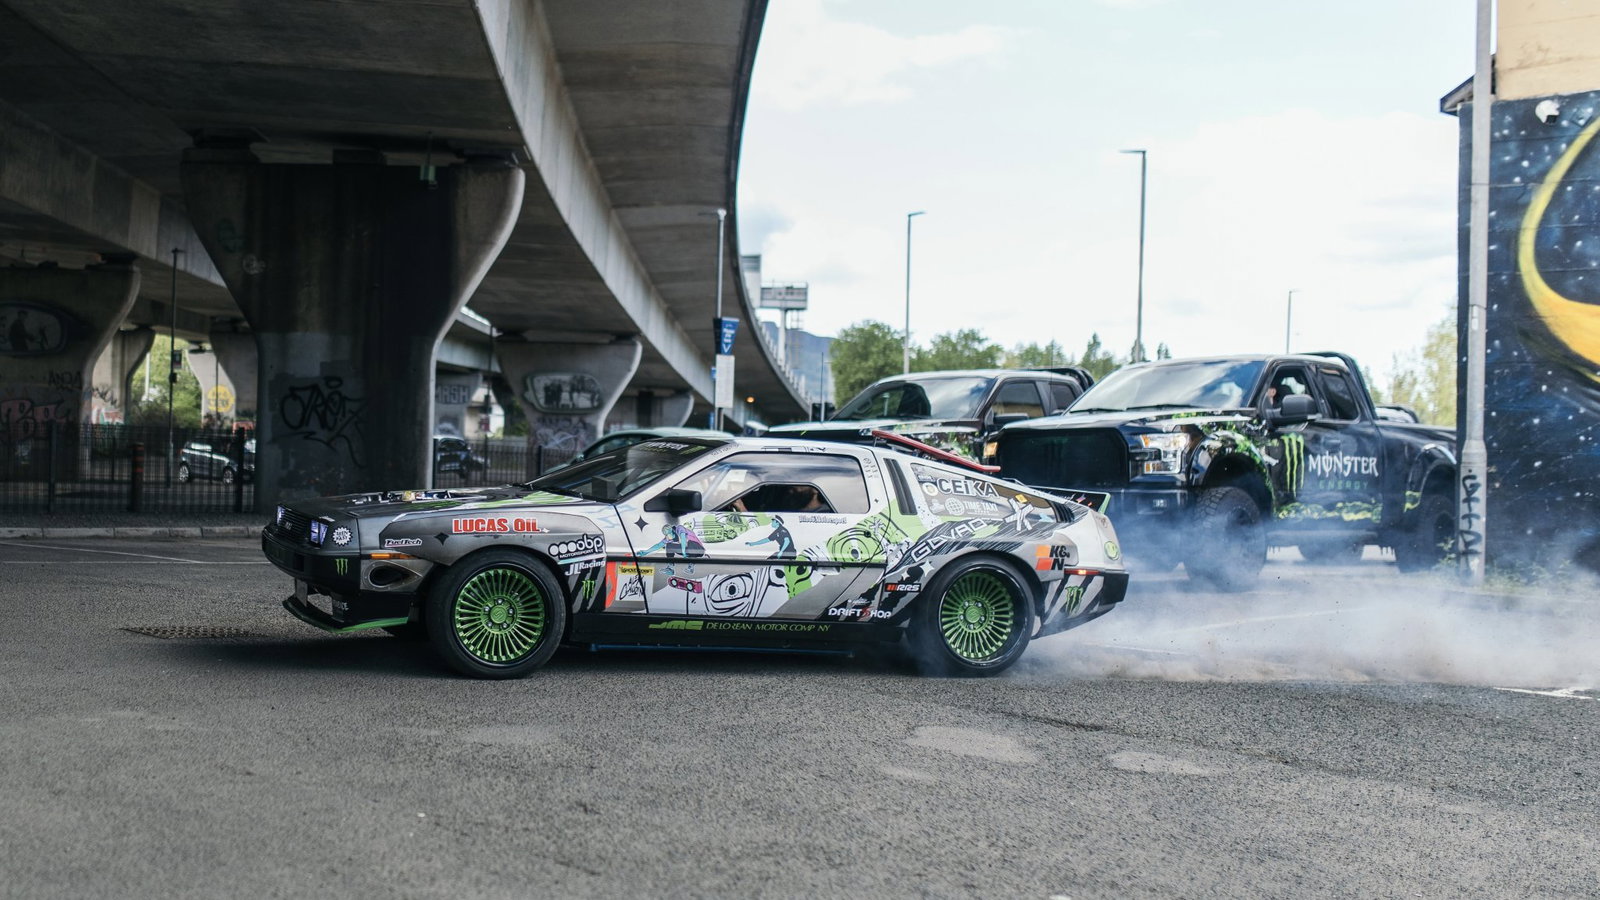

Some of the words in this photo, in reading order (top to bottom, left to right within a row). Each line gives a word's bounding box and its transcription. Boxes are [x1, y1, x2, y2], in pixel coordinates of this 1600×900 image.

[1308, 451, 1379, 477] MONSTER
[1319, 480, 1369, 490] ENERGY
[963, 501, 981, 511] TIME
[981, 502, 998, 512] TAXI
[452, 518, 508, 533] LUCAS
[559, 549, 594, 559] MOTORSPORT
[579, 561, 606, 570] Racing
[897, 584, 920, 592] RRS
[755, 623, 788, 631] MOTOR
